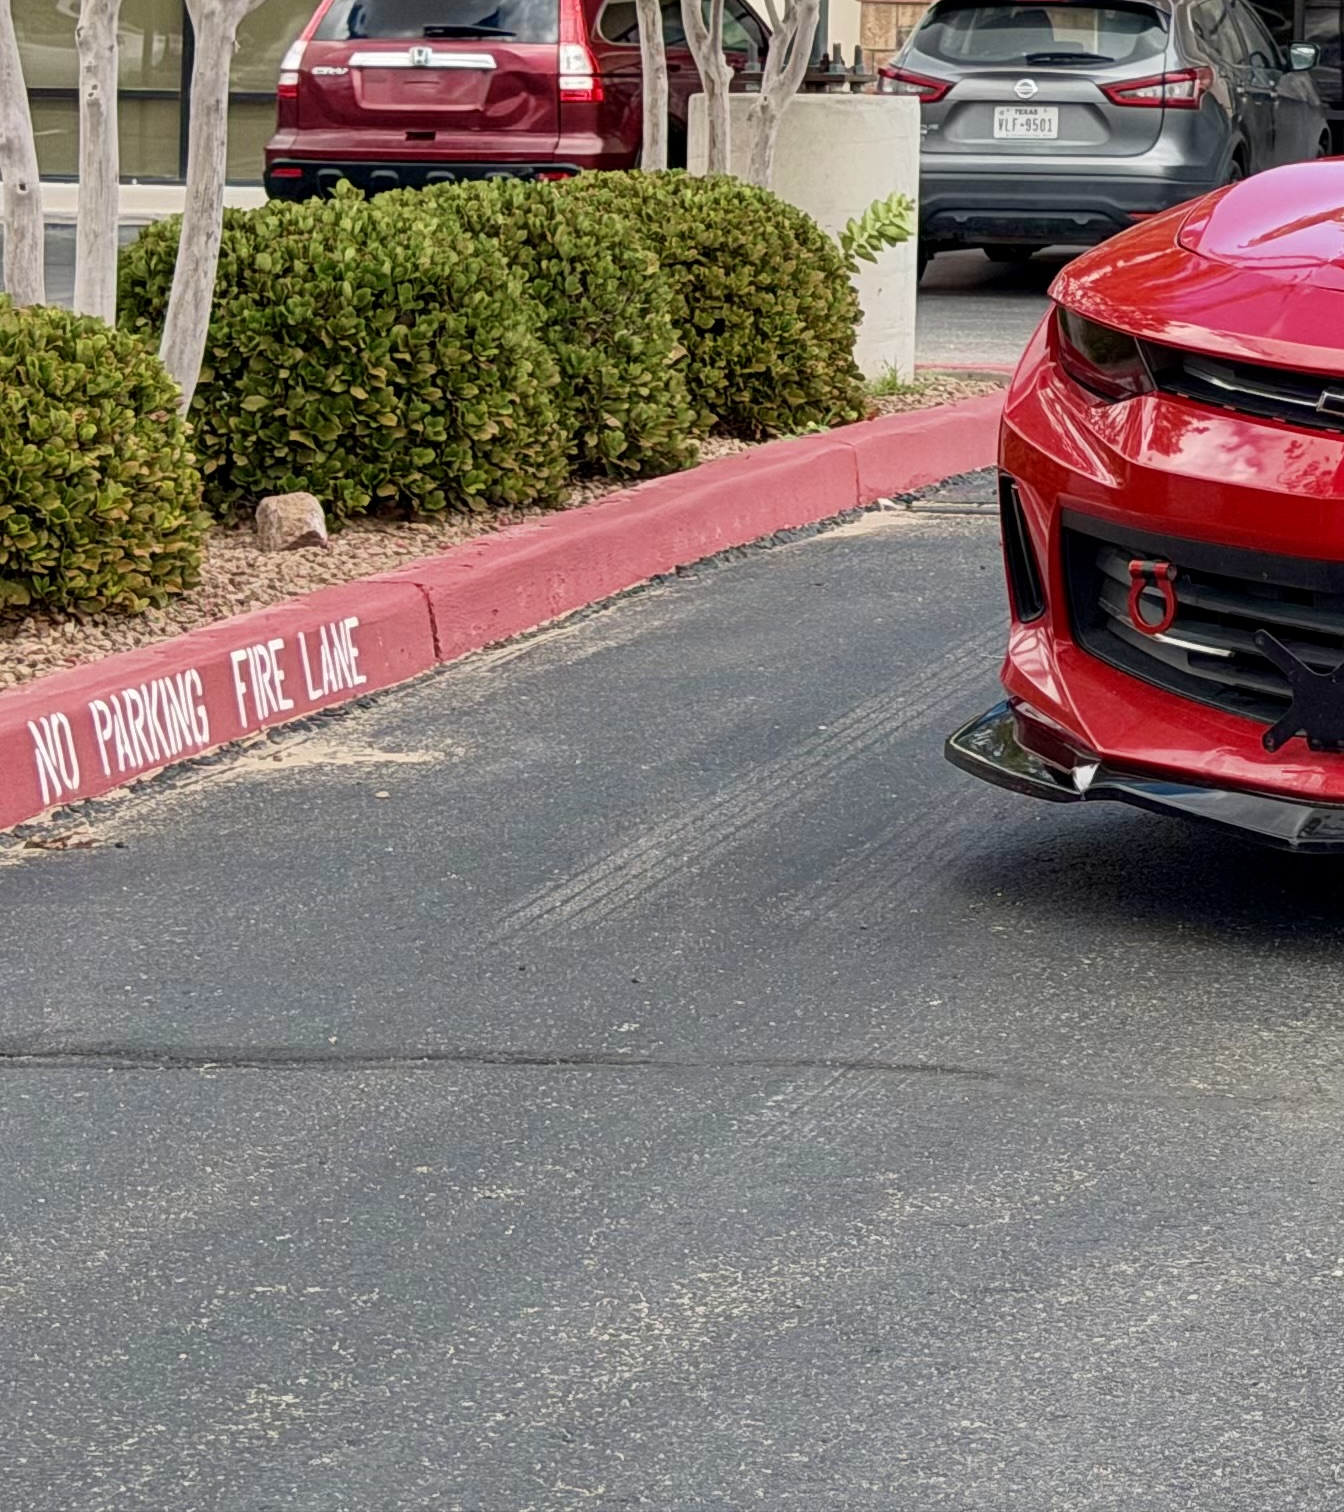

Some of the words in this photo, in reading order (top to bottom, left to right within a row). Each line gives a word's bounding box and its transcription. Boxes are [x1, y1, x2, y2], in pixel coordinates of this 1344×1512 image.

[27, 712, 81, 806] NO
[88, 667, 210, 777] PARKING
[229, 637, 294, 729] FIRE
[298, 615, 367, 702] LANE
